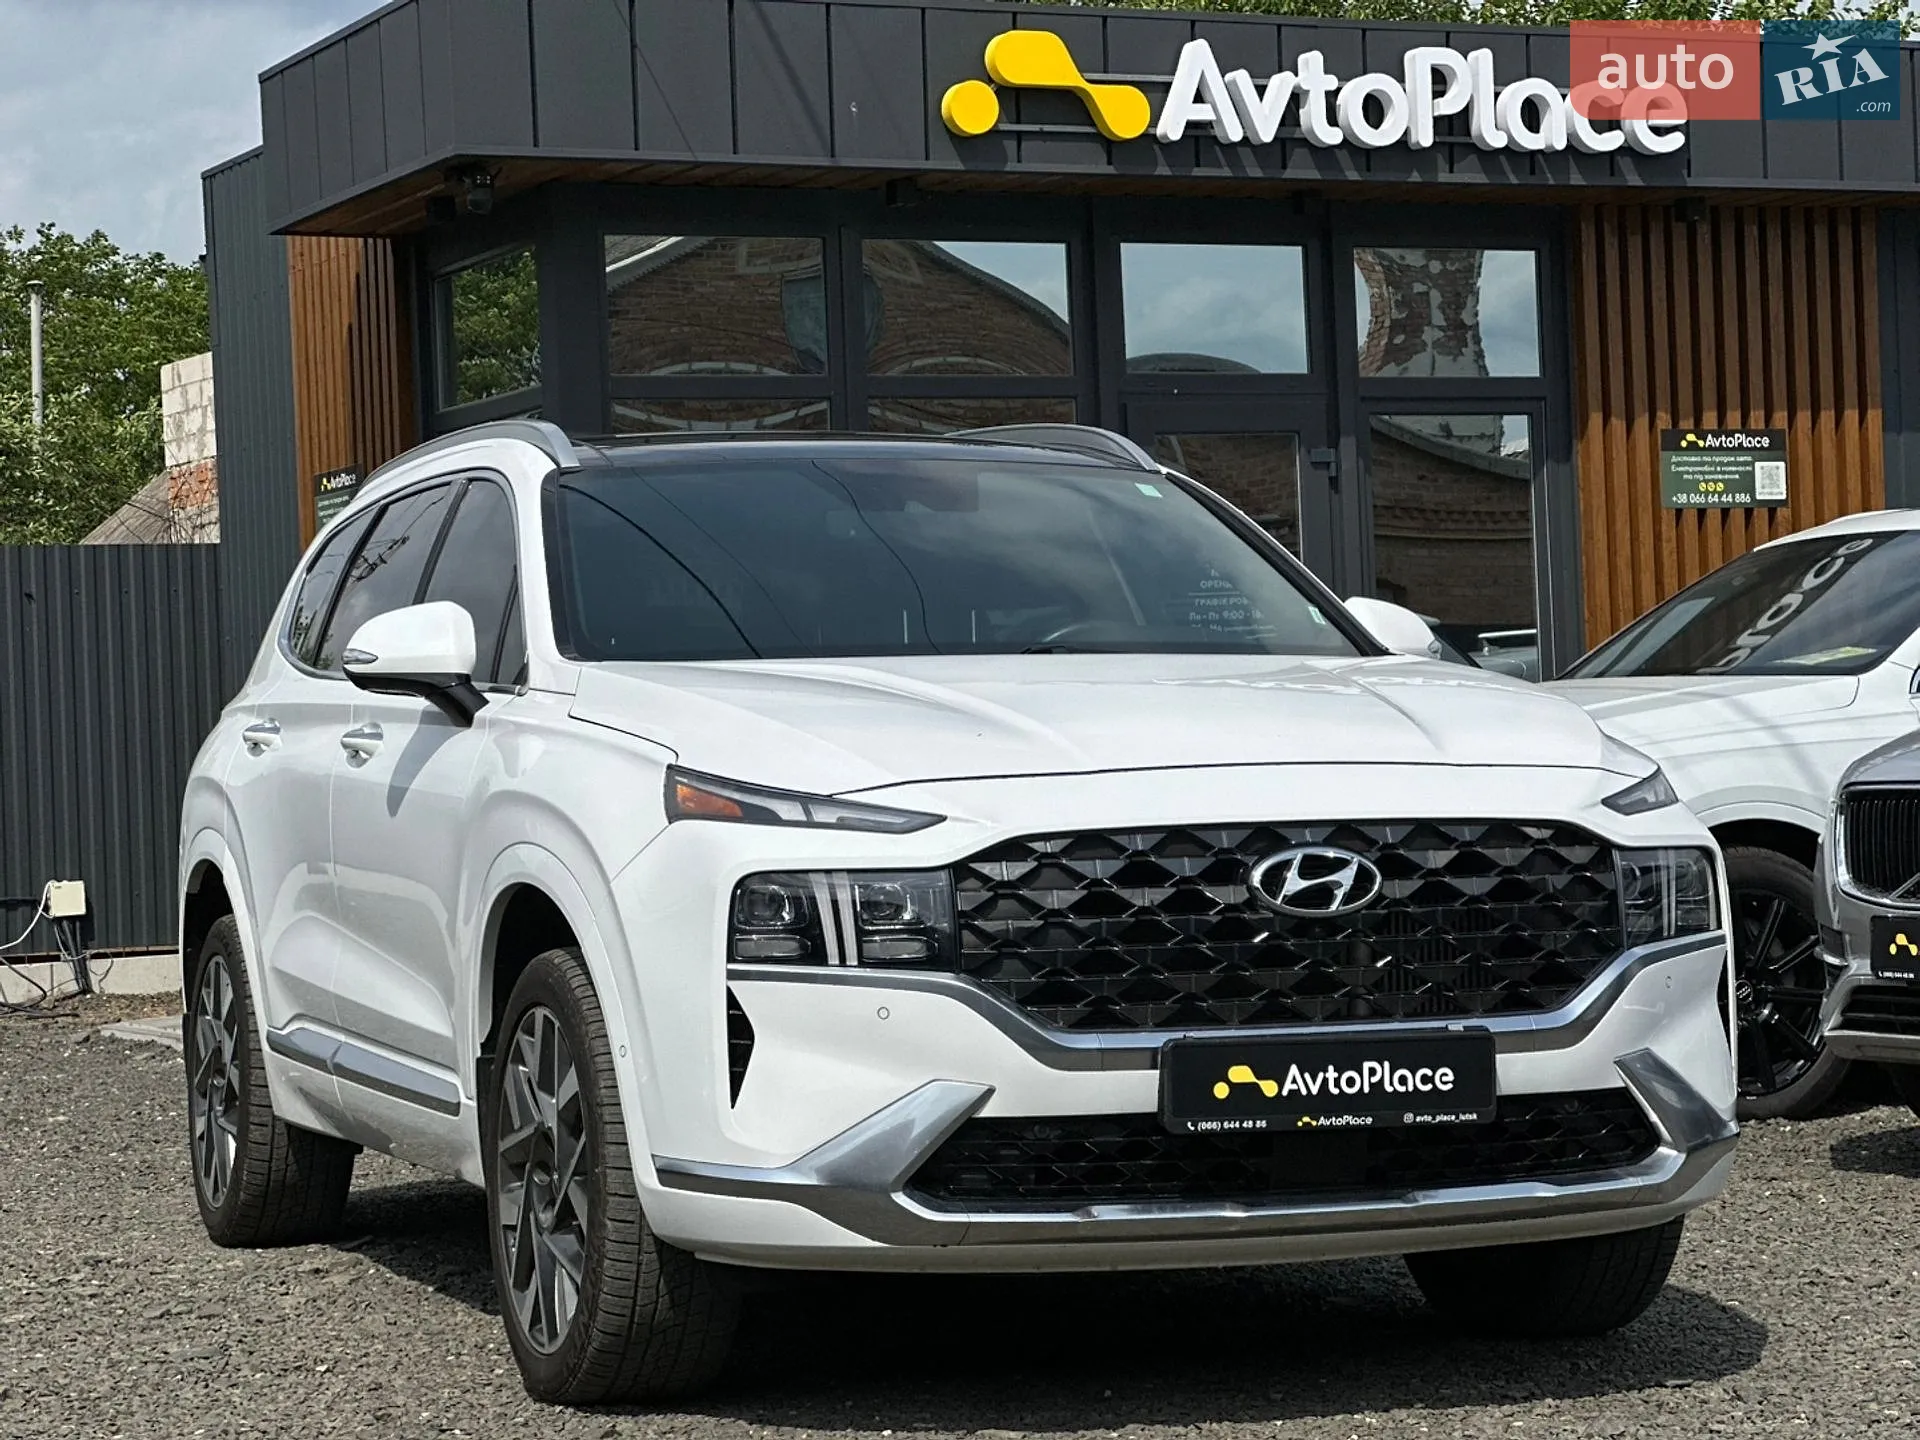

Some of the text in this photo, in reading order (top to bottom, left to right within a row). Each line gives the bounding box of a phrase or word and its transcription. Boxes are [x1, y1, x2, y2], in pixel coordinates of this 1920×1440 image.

[1156, 38, 1688, 155] AvtoPlace
[1705, 433, 1770, 448] AvtoPlace
[1672, 493, 1688, 503] +38
[1689, 493, 1706, 503] 066
[1707, 493, 1719, 503] 64
[1720, 493, 1733, 503] 44
[1735, 493, 1752, 503] 886
[1282, 1060, 1455, 1097] AvtoPlace
[1318, 1116, 1373, 1127] AvtoPlace
